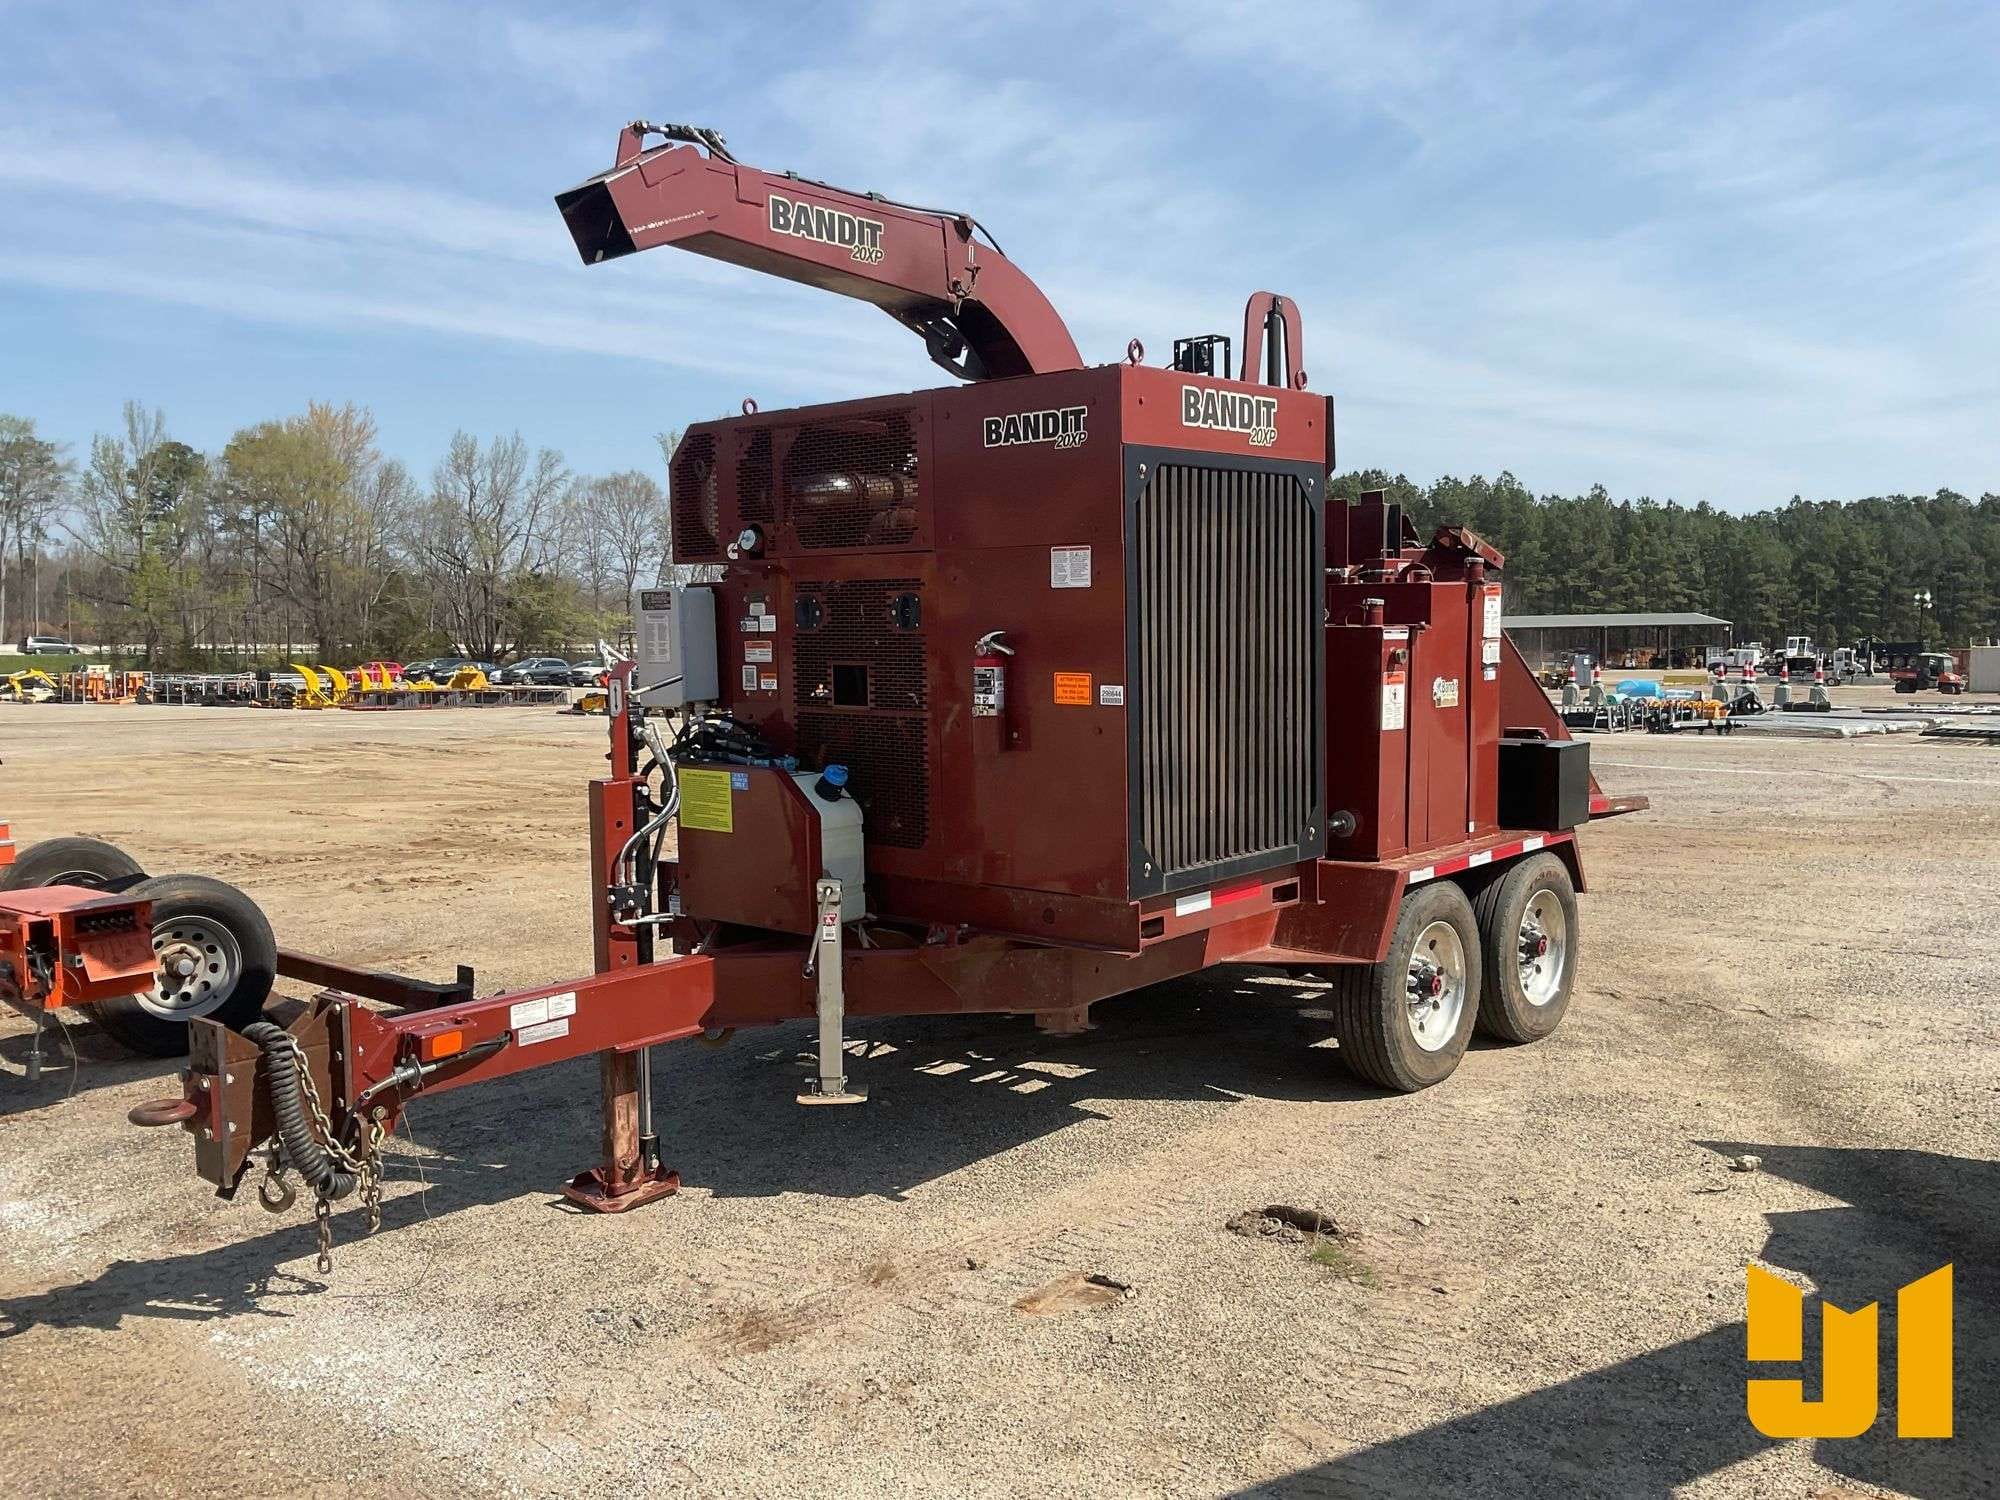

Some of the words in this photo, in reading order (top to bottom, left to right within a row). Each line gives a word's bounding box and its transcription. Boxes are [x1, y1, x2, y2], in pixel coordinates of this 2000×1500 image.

[770, 195, 884, 249] BANDIT
[851, 244, 884, 265] 20XP
[1182, 385, 1277, 432] BANDIT
[984, 406, 1087, 447] BANDIT
[1055, 431, 1088, 449] 20XP
[1249, 427, 1277, 446] 20XP
